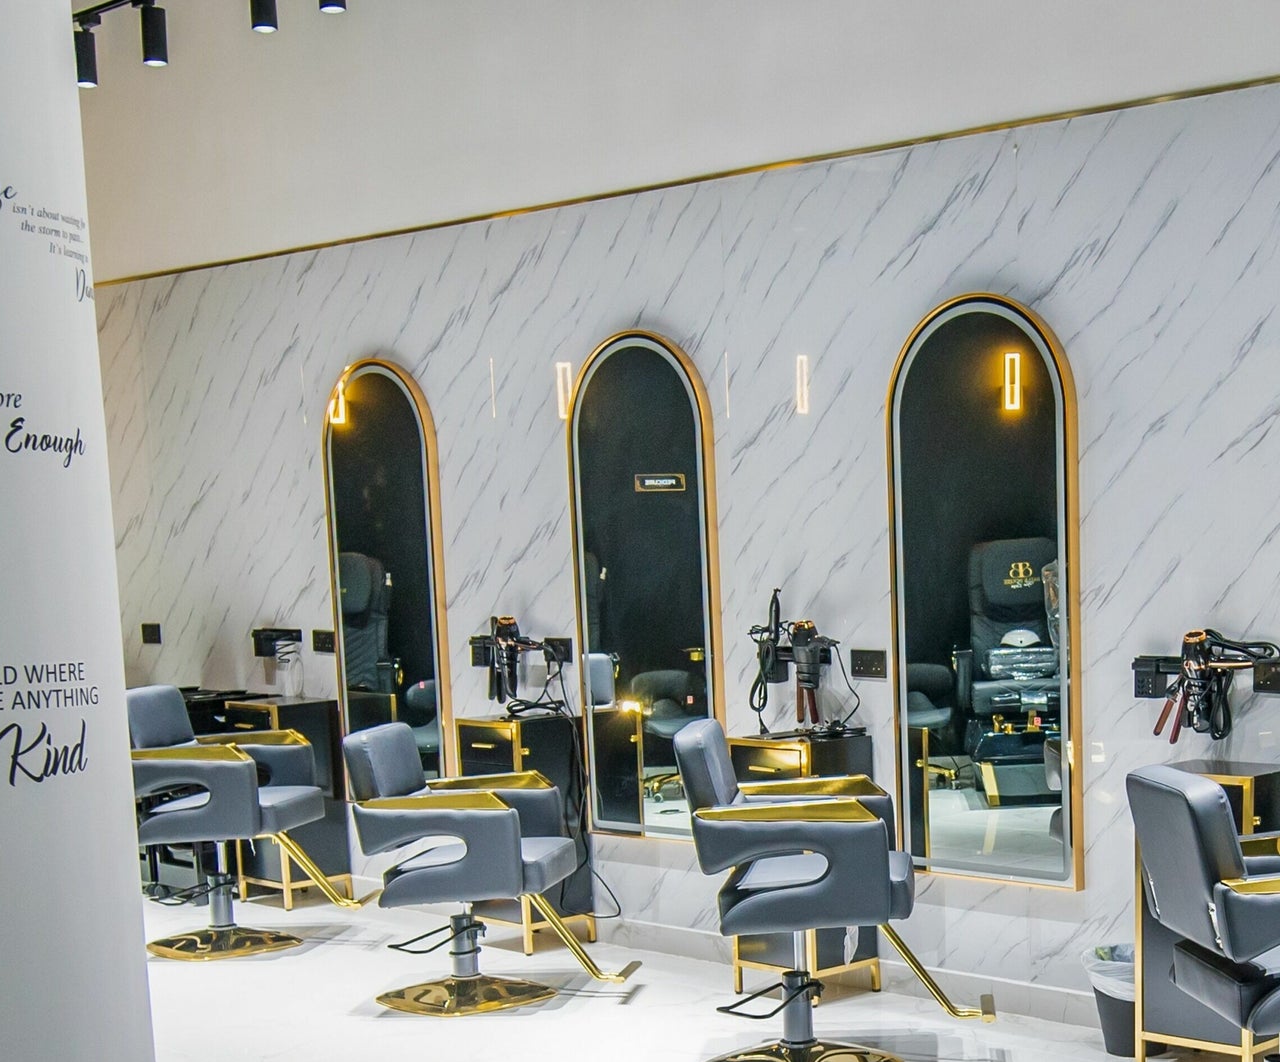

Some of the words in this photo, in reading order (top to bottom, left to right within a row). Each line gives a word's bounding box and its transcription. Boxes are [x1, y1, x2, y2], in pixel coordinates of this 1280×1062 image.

[37, 208, 60, 221] about
[20, 220, 37, 233] the
[38, 225, 61, 238] storm
[5, 417, 86, 468] Enough
[24, 662, 85, 684] WHERE
[11, 686, 99, 710] ANYTHING
